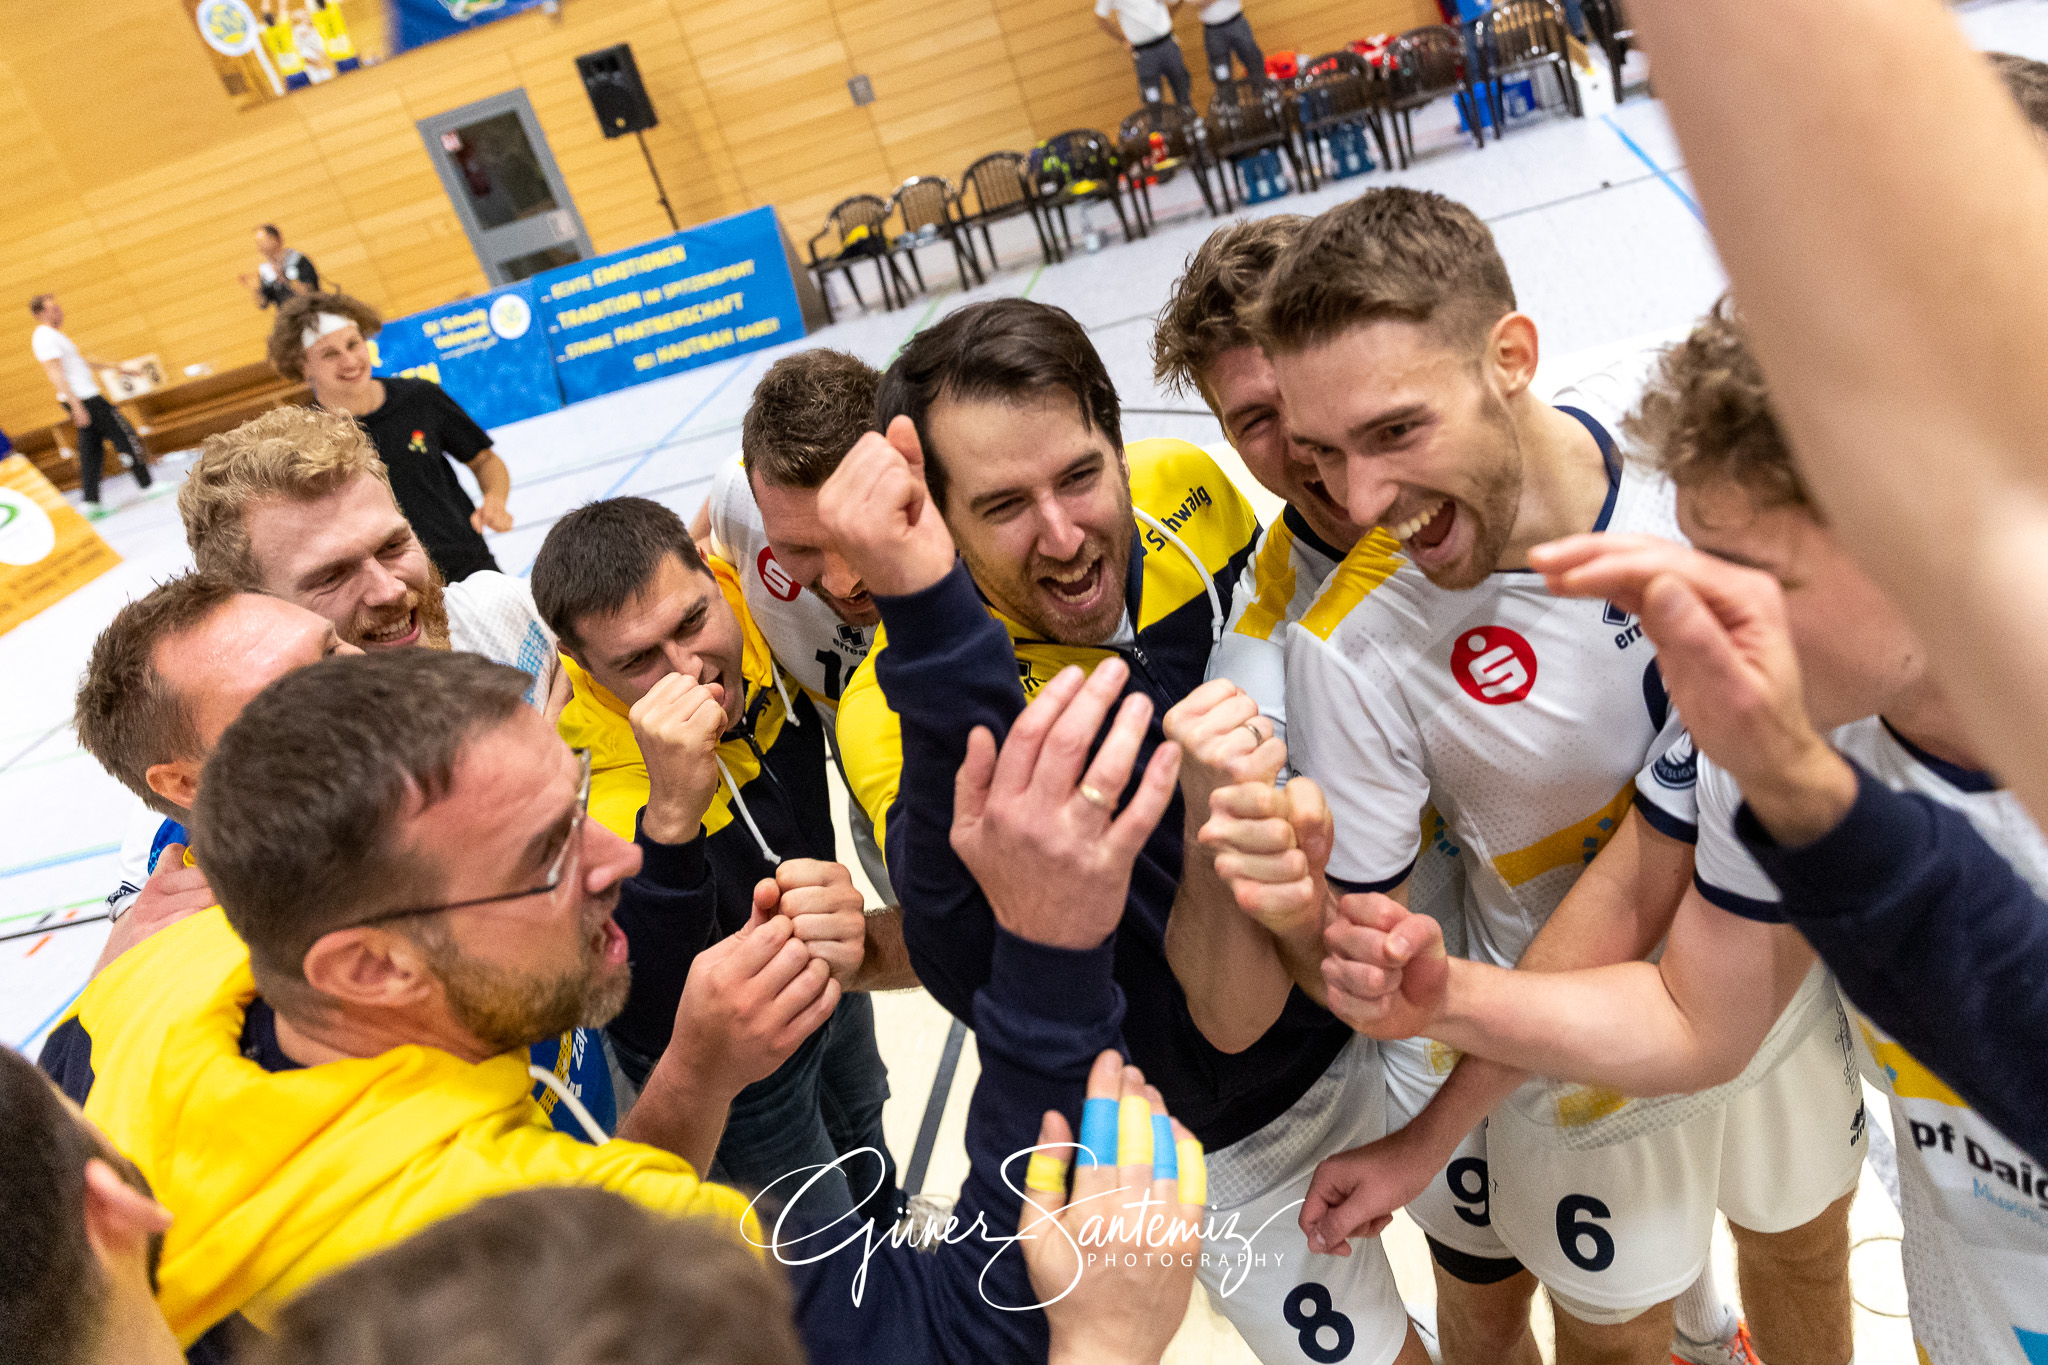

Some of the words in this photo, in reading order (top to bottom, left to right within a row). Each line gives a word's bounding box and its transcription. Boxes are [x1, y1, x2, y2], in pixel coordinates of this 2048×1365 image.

[592, 244, 687, 288] EMOTIONEN
[613, 292, 744, 345] PARTNERSCHAFT
[1146, 486, 1212, 552] Shwaig
[1446, 1157, 1491, 1227] 9
[1556, 1194, 1615, 1273] 6
[1283, 1282, 1355, 1364] 8
